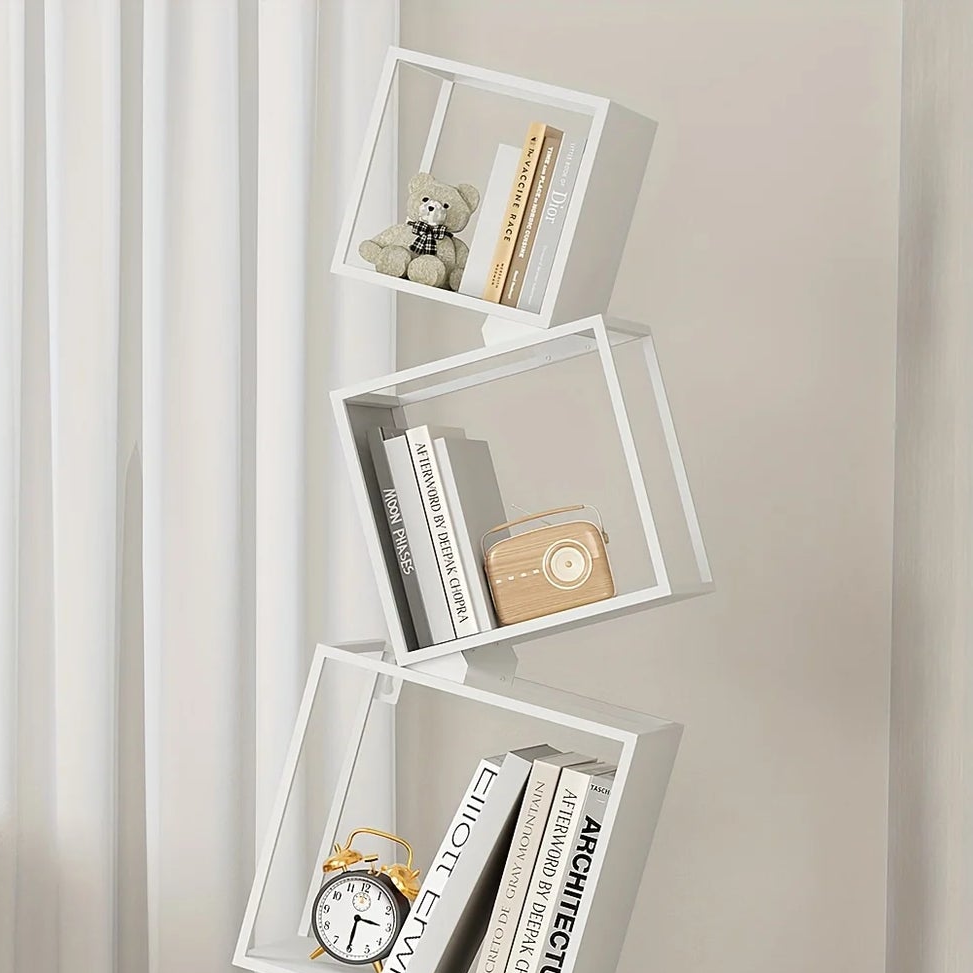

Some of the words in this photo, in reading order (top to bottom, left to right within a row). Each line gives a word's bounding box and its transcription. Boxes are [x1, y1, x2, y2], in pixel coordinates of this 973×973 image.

[513, 160, 531, 208] VACCINE
[535, 175, 545, 198] PLACE
[526, 203, 537, 229] NORDIC
[546, 190, 567, 224] Dior
[504, 214, 517, 242] RACE
[519, 230, 529, 258] CUISINE
[415, 443, 441, 512] AFTERWORD
[383, 489, 402, 524] MOON
[393, 528, 414, 575] PHASES
[434, 515, 446, 529] BY
[438, 533, 457, 575] DEEPAK
[449, 578, 469, 623] CHOPRA
[544, 788, 578, 877] AFTERWORD
[499, 906, 511, 924] DE
[506, 864, 523, 899] GRAY
[517, 781, 545, 860] MOUNTAIN
[333, 890, 342, 900] 10
[347, 883, 355, 893] 11
[361, 883, 371, 893] 12
[377, 892, 382, 900] 1
[535, 880, 552, 900] BY
[323, 904, 330, 914] 9
[385, 906, 391, 915] 2
[324, 921, 330, 930] 8
[385, 923, 392, 932] 3
[519, 902, 547, 956] DEEPAK
[333, 935, 339, 944] 7
[364, 945, 370, 954] 5
